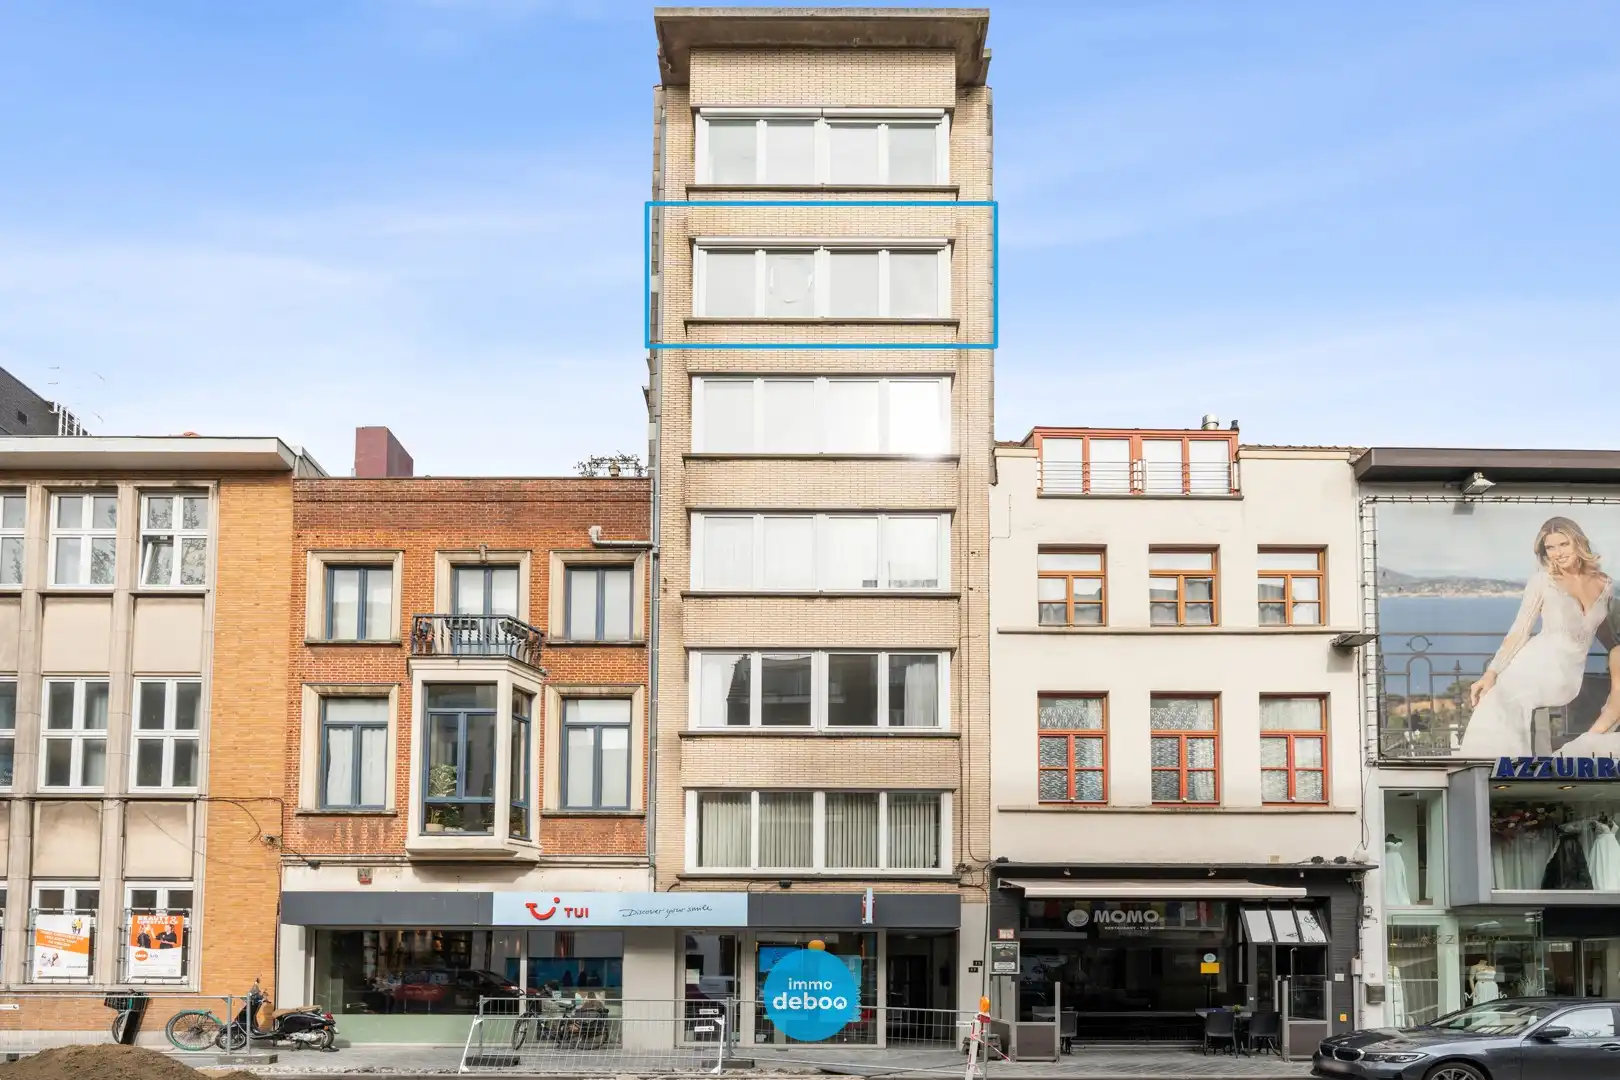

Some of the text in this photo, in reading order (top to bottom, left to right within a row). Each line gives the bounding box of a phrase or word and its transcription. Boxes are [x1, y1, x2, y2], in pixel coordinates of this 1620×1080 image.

[1493, 756, 1620, 778] AZZURR
[564, 904, 713, 919] TUI Discover your smile
[1093, 910, 1160, 923] MOMO
